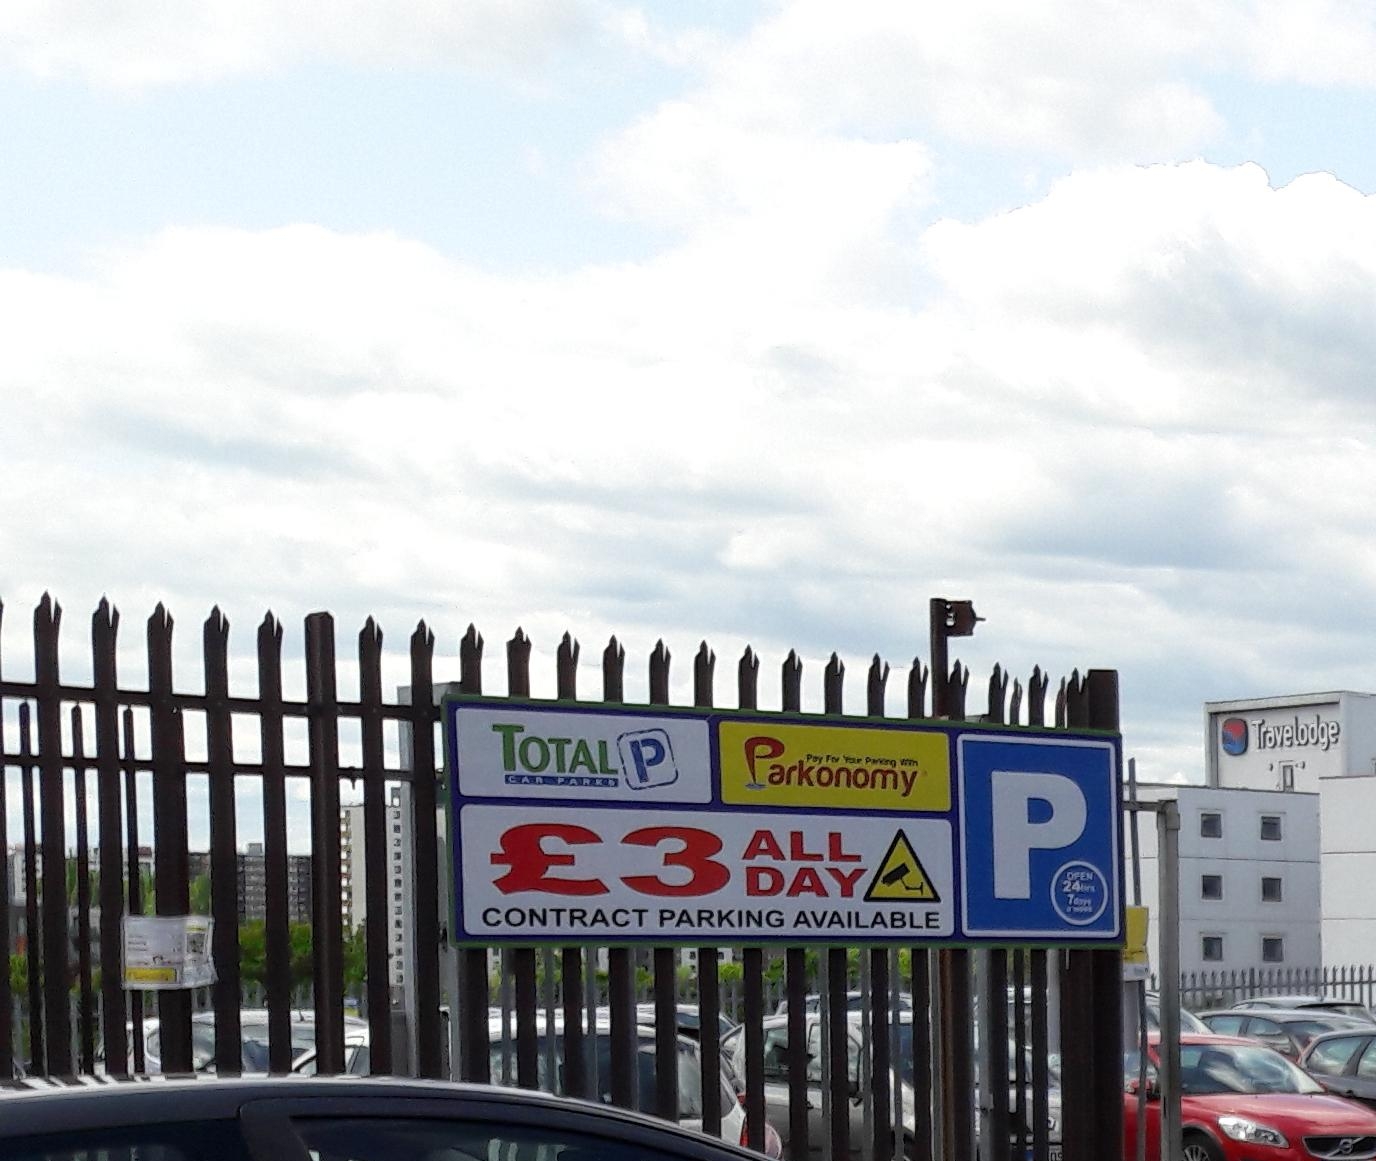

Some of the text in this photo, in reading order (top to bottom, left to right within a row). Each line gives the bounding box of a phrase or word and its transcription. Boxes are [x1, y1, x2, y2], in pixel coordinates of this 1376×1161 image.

[1252, 714, 1340, 751] Travelodge
[744, 736, 918, 797] Parkonomy
[806, 753, 823, 764] Pay
[865, 756, 897, 768] Parking
[508, 776, 544, 785] CAR
[741, 829, 864, 863] ALL
[992, 771, 1087, 899] P
[490, 823, 731, 898] £3
[1066, 871, 1094, 881] OPEN
[745, 866, 869, 899] DAY
[482, 907, 941, 929] CONTRACT PARKING AVAILABLE
